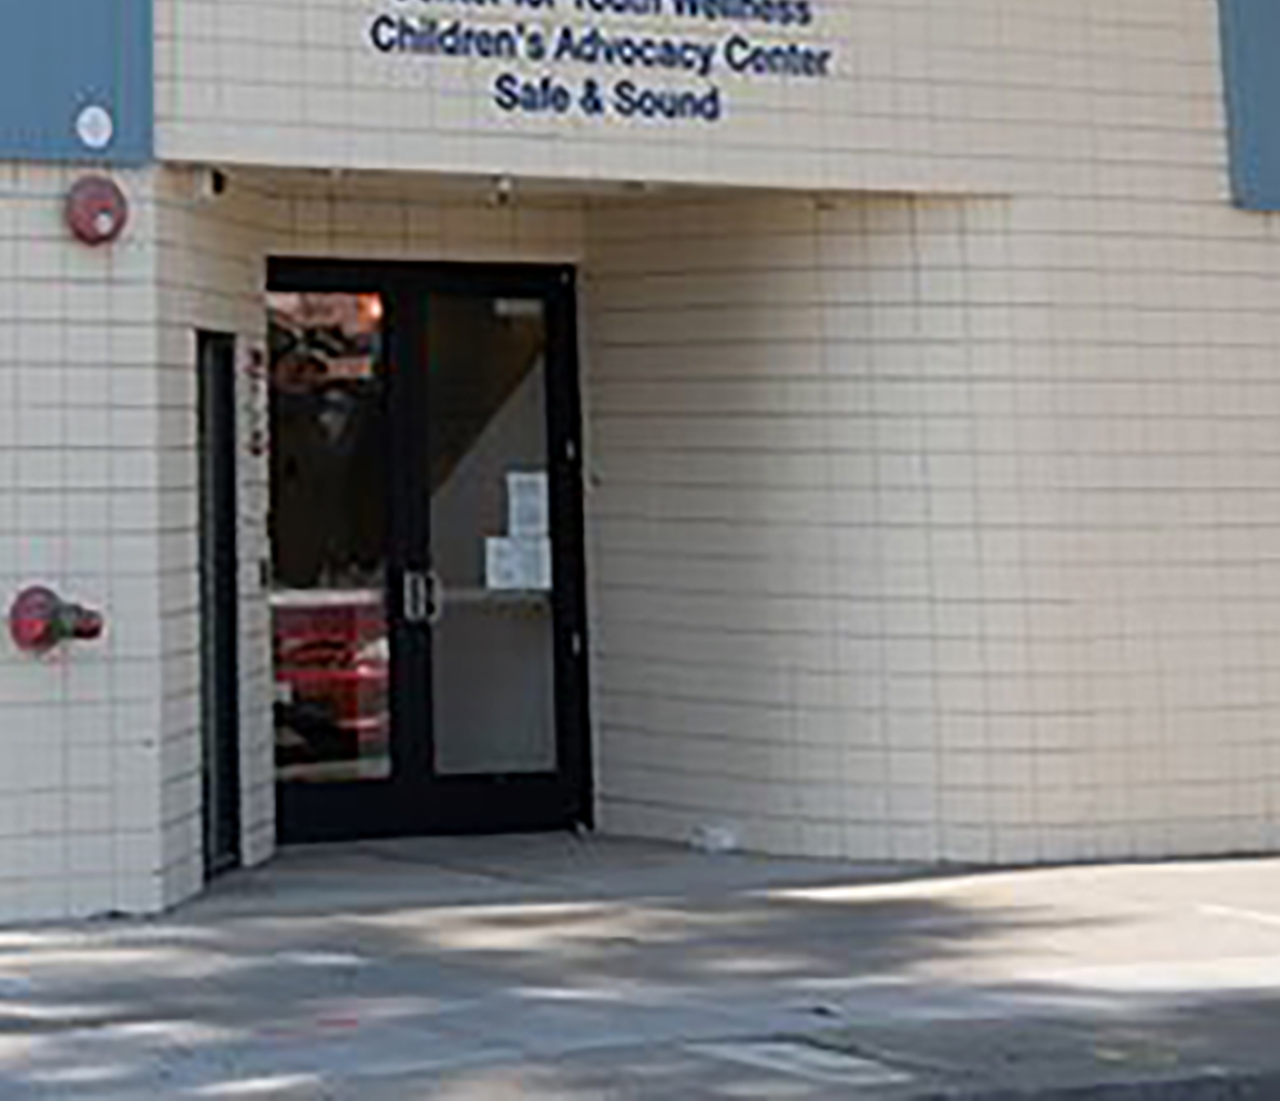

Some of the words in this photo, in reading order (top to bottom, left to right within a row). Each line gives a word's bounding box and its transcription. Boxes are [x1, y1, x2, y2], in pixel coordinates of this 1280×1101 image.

[369, 13, 547, 62] Children's
[553, 25, 716, 78] Advocacy
[723, 34, 832, 77] Center
[494, 72, 571, 114] Safe
[578, 77, 605, 116] &
[613, 79, 721, 122] Sound
